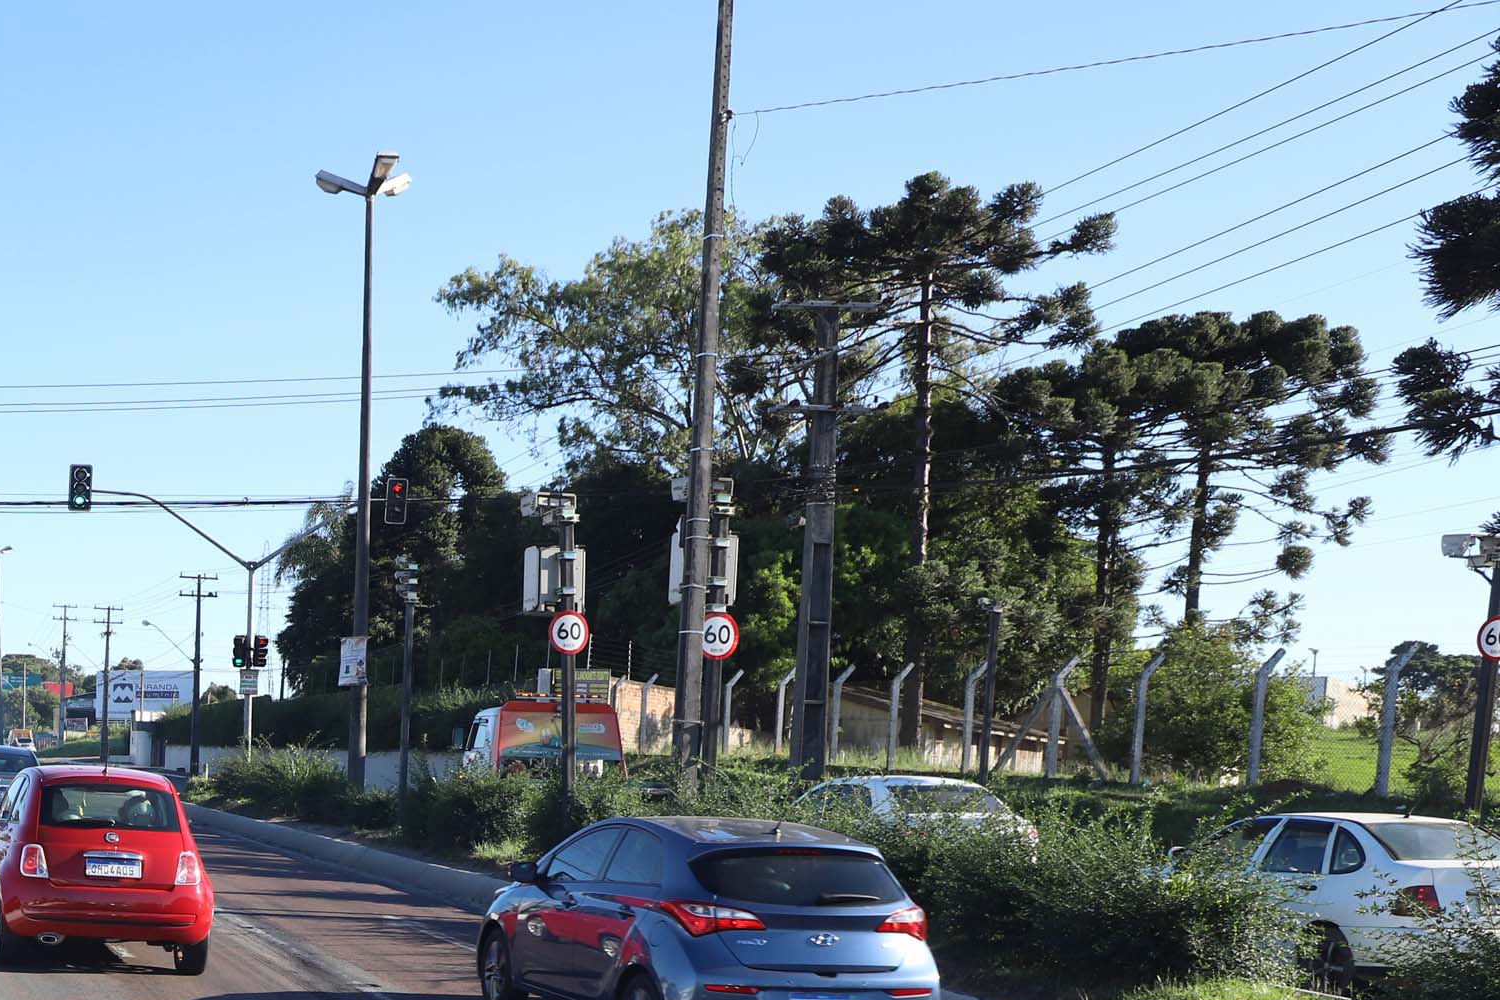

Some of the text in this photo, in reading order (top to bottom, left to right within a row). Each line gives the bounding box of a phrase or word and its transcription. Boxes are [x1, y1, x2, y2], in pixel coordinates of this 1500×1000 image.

[557, 622, 581, 641] 60
[704, 624, 731, 645] 60
[1485, 627, 1500, 646] 6
